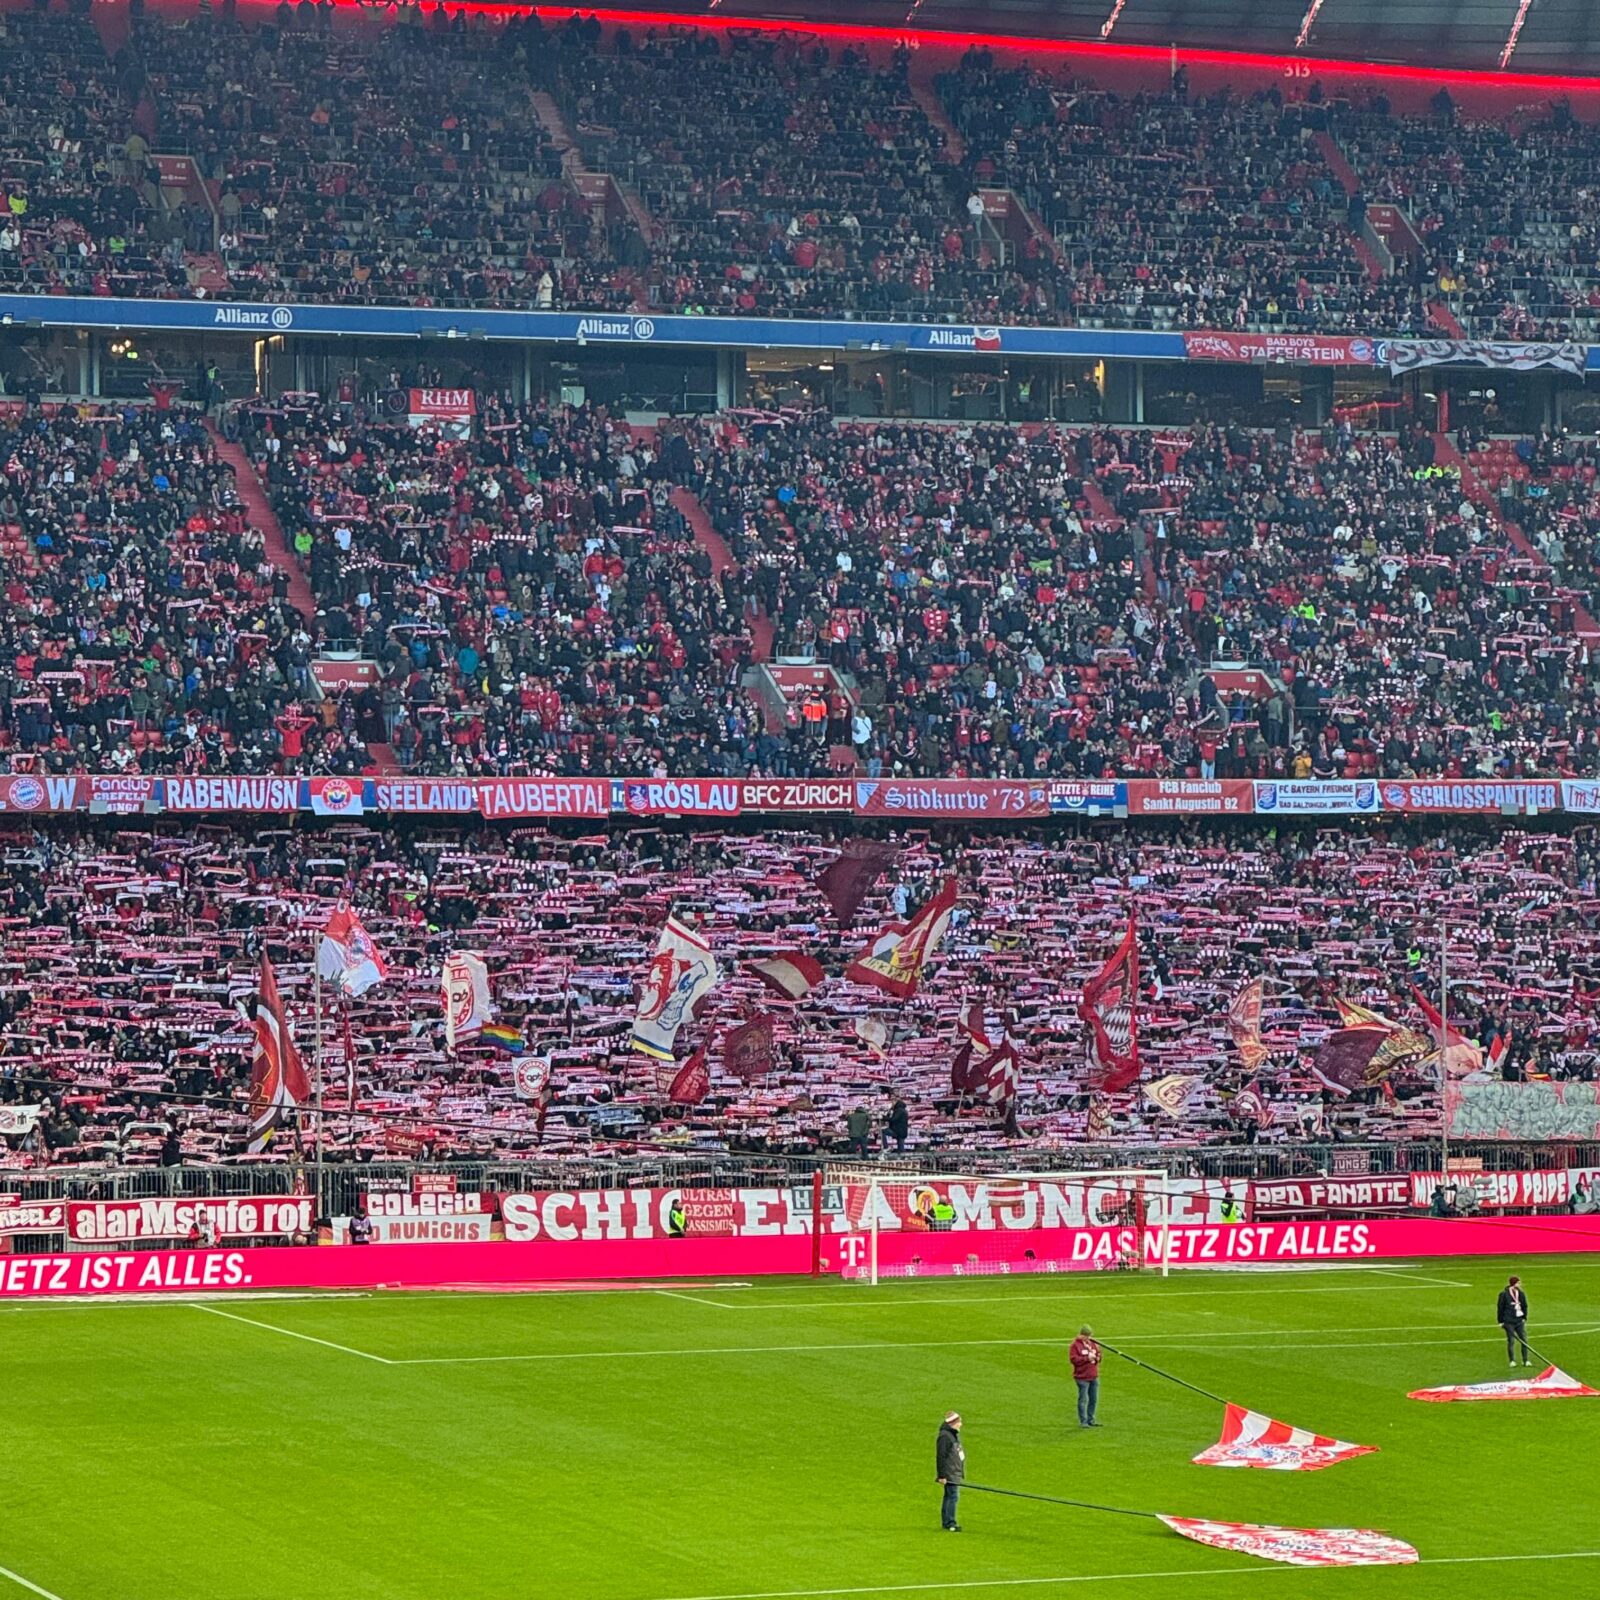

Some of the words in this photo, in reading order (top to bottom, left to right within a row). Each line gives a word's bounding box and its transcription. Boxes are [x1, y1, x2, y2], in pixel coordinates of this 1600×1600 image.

[1284, 63, 1311, 78] 313
[215, 308, 269, 324] Allianz
[578, 319, 629, 335] Allianz
[1266, 337, 1287, 347] BAD
[1289, 338, 1315, 347] BOYS
[1240, 346, 1344, 361] STAFFELSTEIN
[421, 389, 469, 405] RHM
[91, 777, 151, 791] Fanclub
[1052, 784, 1081, 796] LETZTE
[1090, 784, 1115, 796] REIHE
[1159, 781, 1179, 794] FCB
[1180, 781, 1222, 794] Fanclub
[1279, 785, 1289, 794] FC
[1291, 785, 1320, 794] BAYERN
[1322, 785, 1354, 793] FREUNDE
[45, 778, 76, 810] W
[166, 779, 298, 810] RABENAU/SN
[377, 785, 472, 811] SEELAND
[480, 784, 608, 814] TAUBERTAL
[648, 783, 738, 808] RÖSLAU
[743, 785, 780, 804] BFC
[784, 783, 851, 805] ZÜRICH
[884, 786, 988, 811] Südkurve
[1410, 785, 1557, 809] SCHLOSSPANTHER
[1143, 797, 1173, 810] Sankt
[1174, 797, 1221, 811] Augustin
[1279, 801, 1291, 809] BAD
[1334, 1159, 1370, 1169] JUNGS!
[682, 1188, 731, 1202] ULTRAS
[1523, 1172, 1567, 1204] PRIDE
[263, 1200, 312, 1232] rot
[682, 1203, 733, 1217] GEGEN
[686, 1219, 734, 1232] ASSISMUS
[1144, 1228, 1219, 1259] NETZ
[1227, 1227, 1275, 1257] IST
[1279, 1224, 1376, 1255] ALLES.
[0, 1259, 70, 1291] ETZ
[79, 1256, 136, 1290] IST
[138, 1252, 253, 1286] ALLES.
